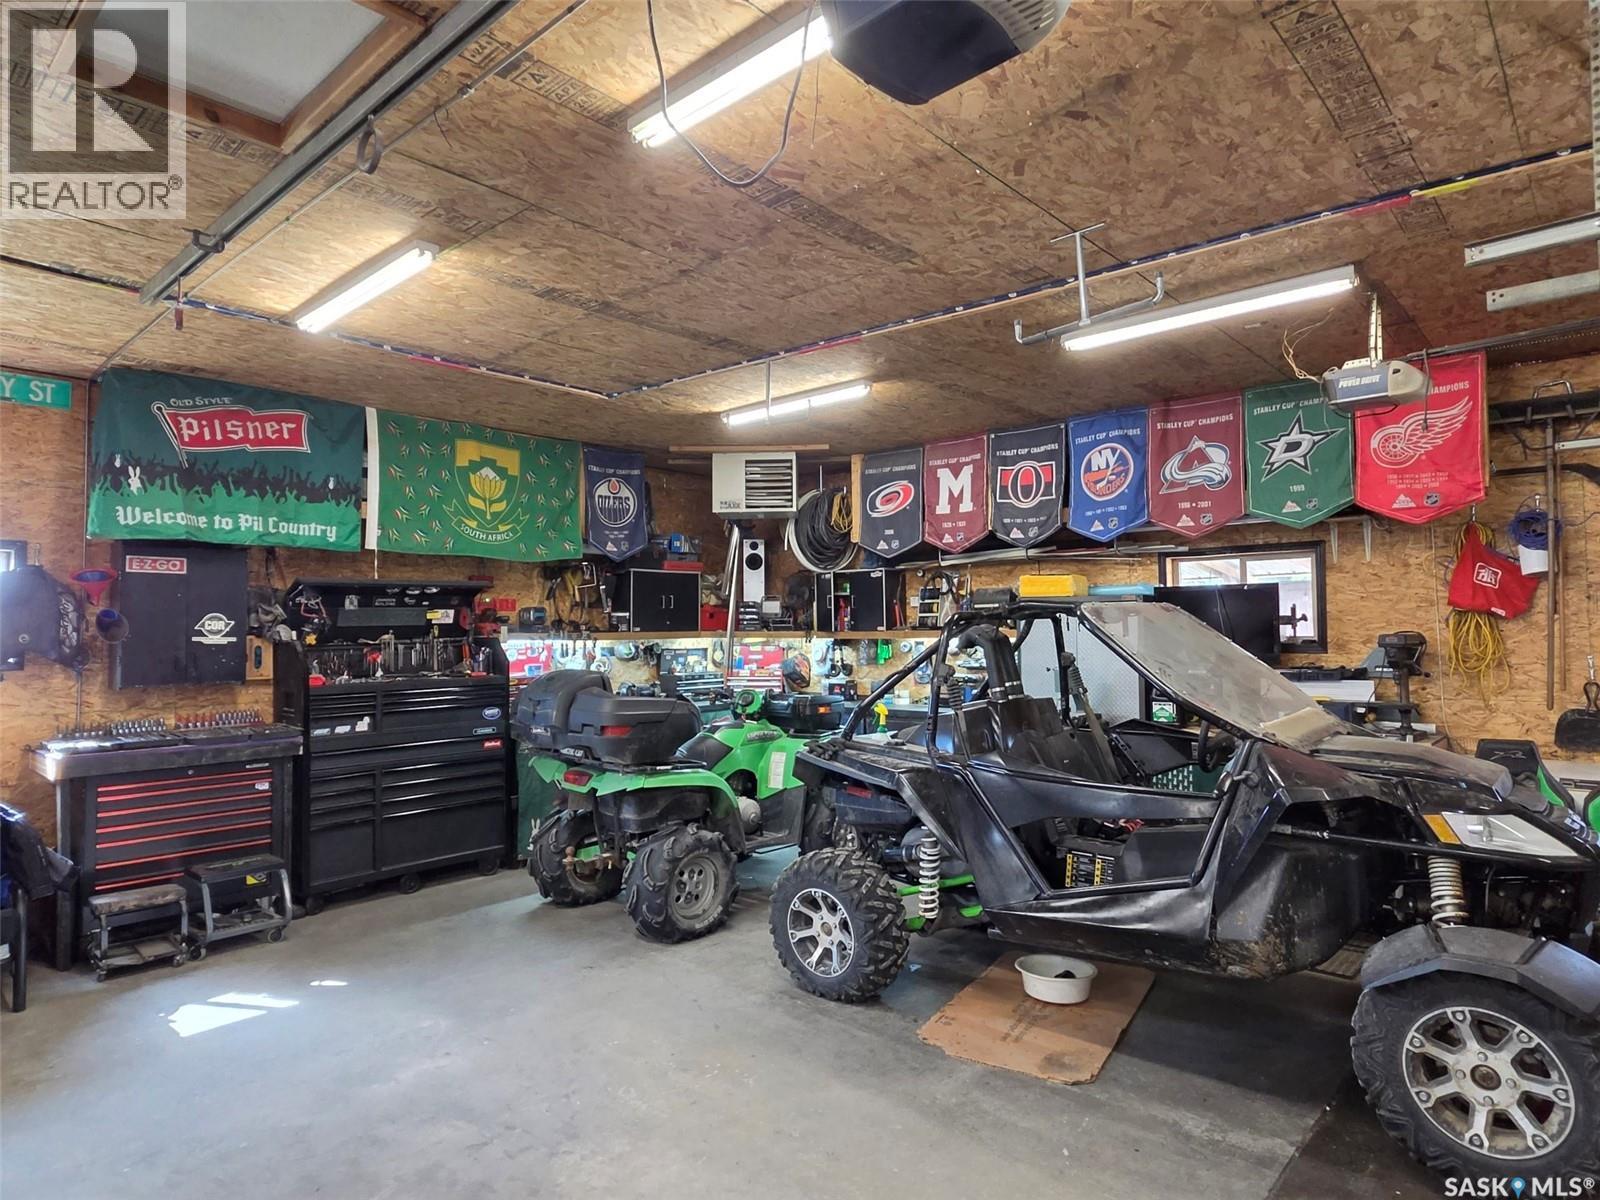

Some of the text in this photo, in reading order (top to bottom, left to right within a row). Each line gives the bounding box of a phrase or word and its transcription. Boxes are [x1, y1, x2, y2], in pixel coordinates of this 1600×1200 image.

[0, 376, 56, 403] Y ST
[1338, 378, 1361, 389] POWER
[1361, 374, 1382, 385] DRIVE
[1427, 381, 1470, 395] HAMPIONS
[1253, 403, 1280, 416] STANLEY
[1281, 400, 1295, 410] CUP
[176, 415, 297, 442] Pilsner
[1156, 413, 1234, 431] STANLEY CUP CHAMPIONS
[1075, 428, 1141, 445] STANLEY CUP CHAMPIONS
[1018, 447, 1029, 455] CUP
[1090, 448, 1120, 471] NY
[935, 464, 974, 515] M
[597, 494, 632, 510] OILERS
[115, 505, 337, 542] Welcome to Pil Country
[459, 523, 514, 542] SOUTH AFRICA
